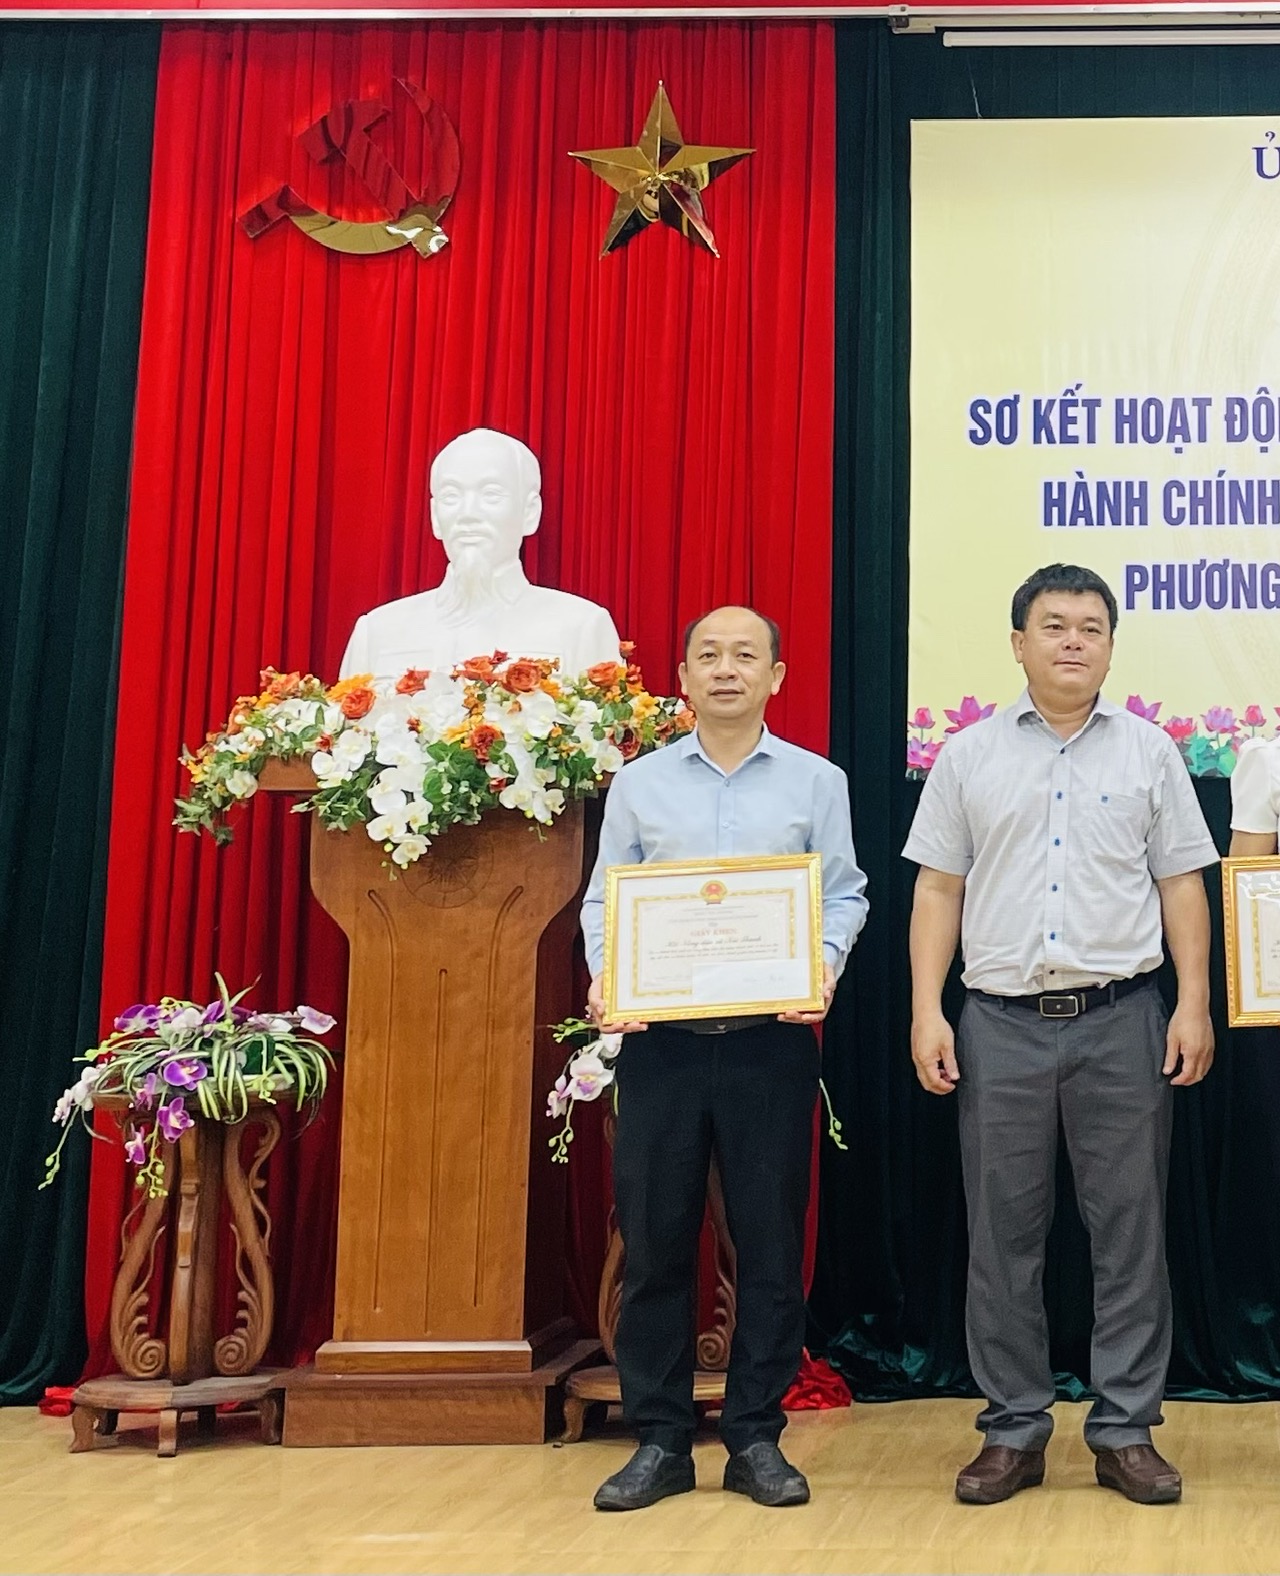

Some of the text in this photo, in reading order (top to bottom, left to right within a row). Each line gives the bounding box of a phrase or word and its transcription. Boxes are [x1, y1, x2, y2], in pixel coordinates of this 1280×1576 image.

[969, 395, 1019, 445] SƠ
[1033, 384, 1101, 444] KẾT
[1116, 398, 1211, 453] HOẠT
[1044, 471, 1148, 526] HÀNH
